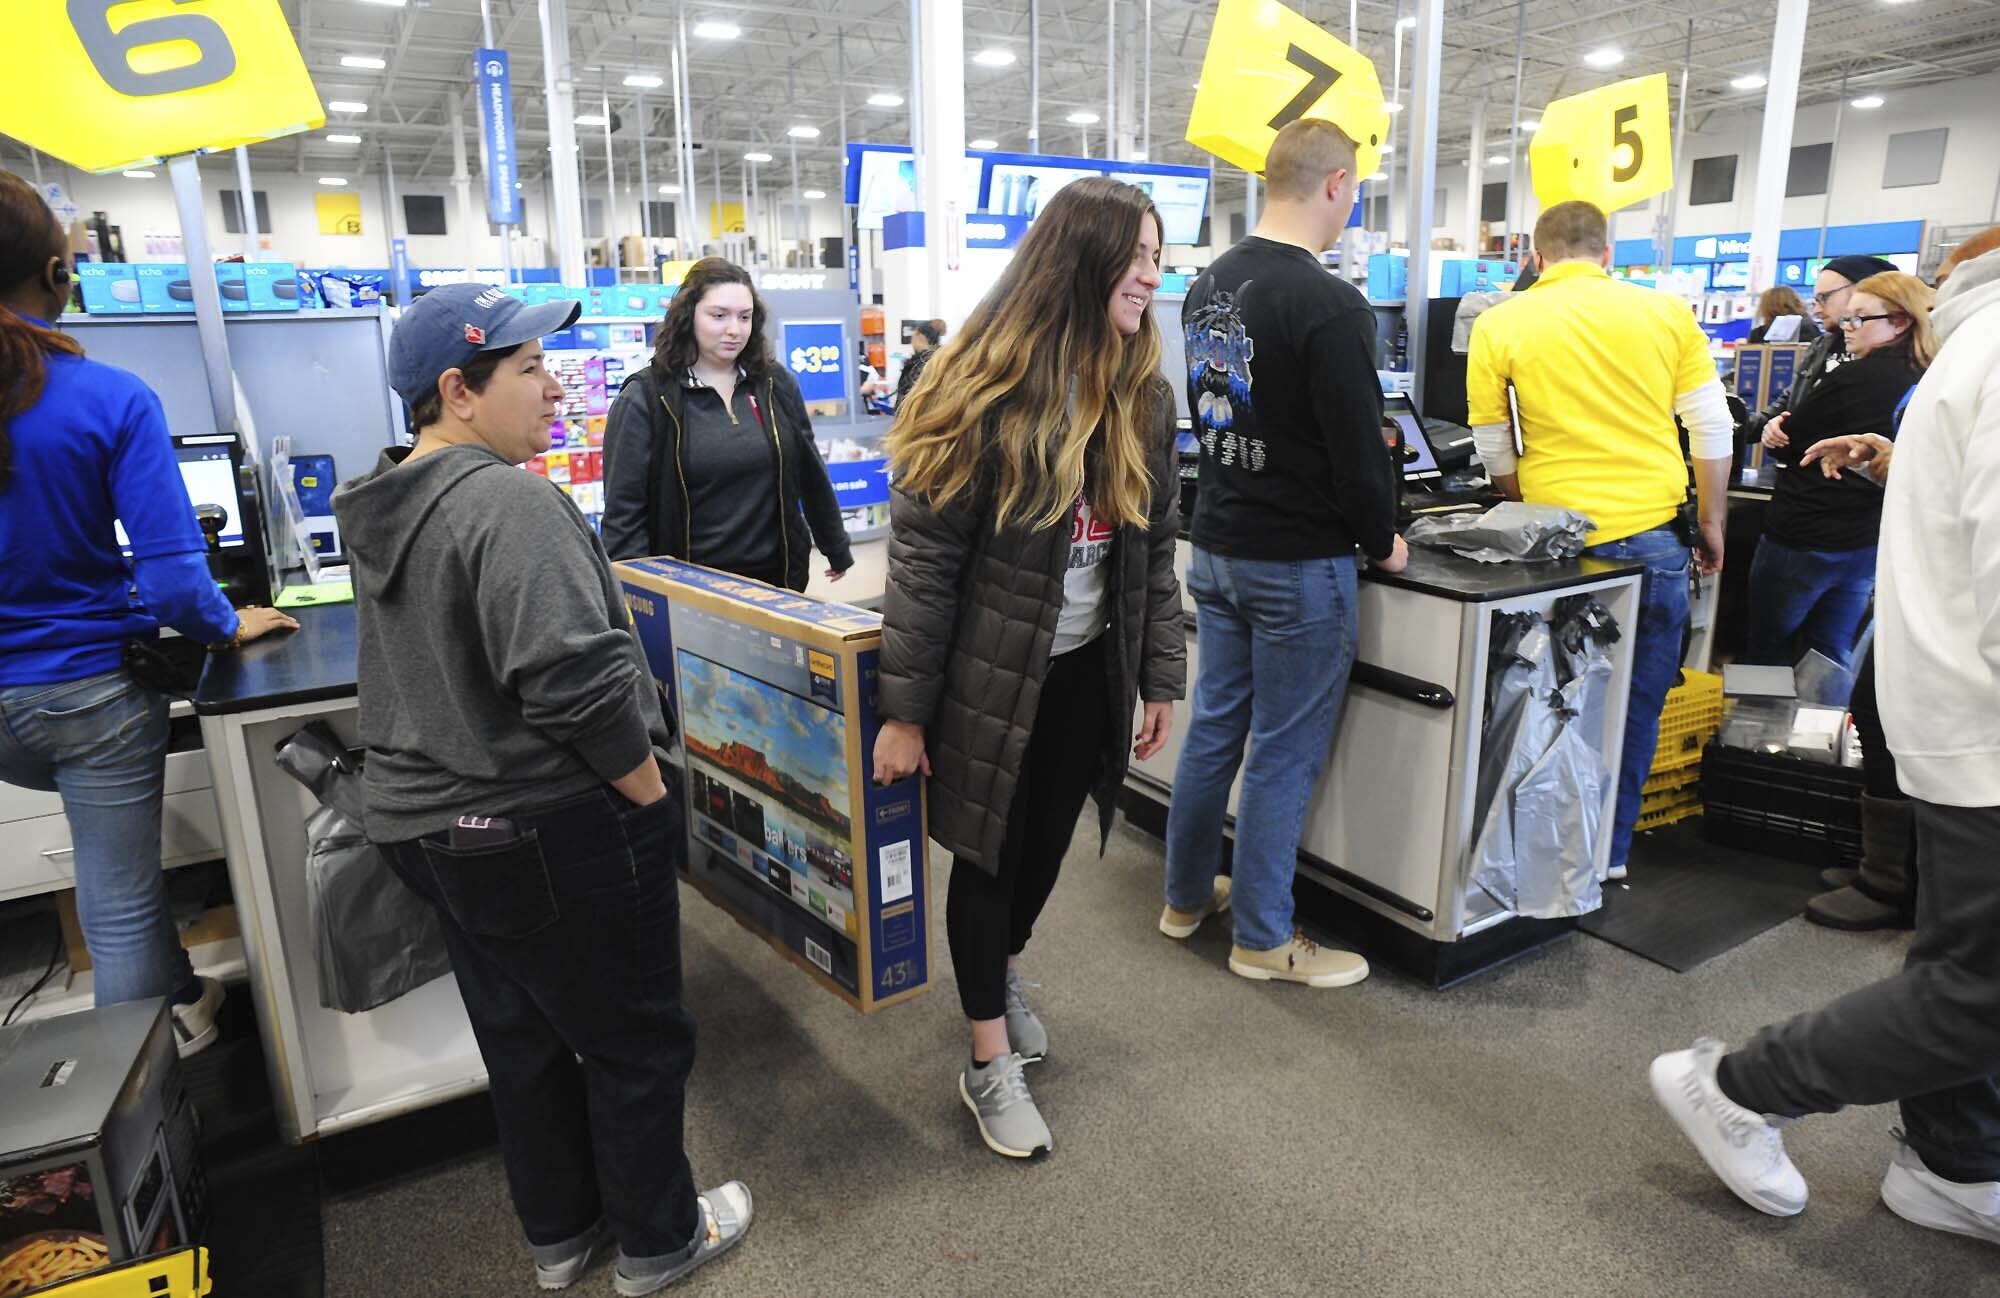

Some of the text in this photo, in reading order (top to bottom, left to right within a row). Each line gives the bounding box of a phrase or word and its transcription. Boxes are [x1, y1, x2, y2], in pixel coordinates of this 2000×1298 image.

[66, 0, 237, 97] 6
[491, 83, 506, 151] HEADPHONES
[1266, 42, 1343, 132] 7
[1613, 104, 1643, 182] 5
[81, 268, 106, 277] echo
[139, 268, 162, 276] echo
[246, 267, 268, 276] echo
